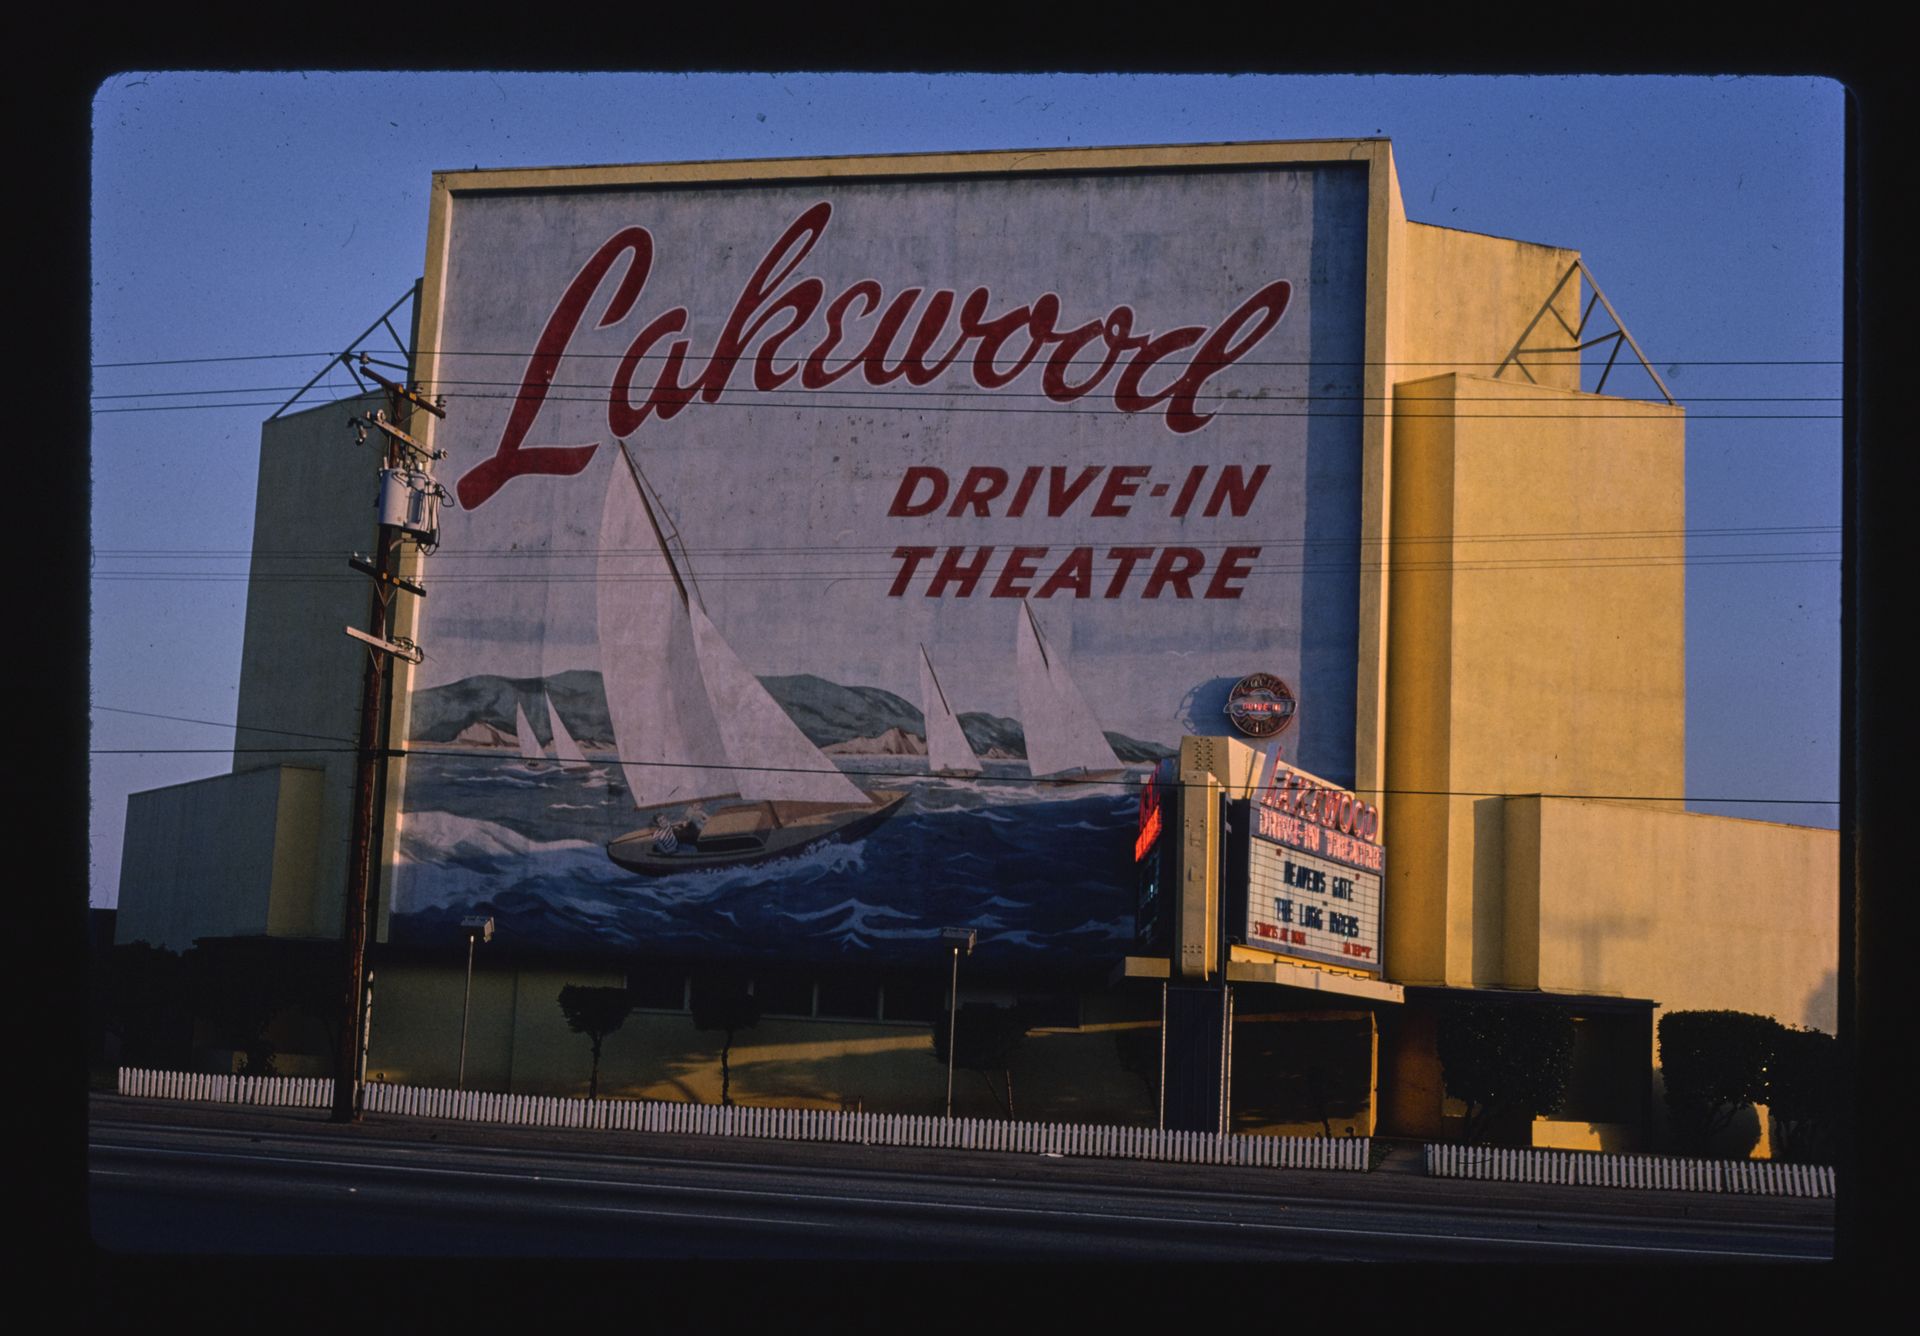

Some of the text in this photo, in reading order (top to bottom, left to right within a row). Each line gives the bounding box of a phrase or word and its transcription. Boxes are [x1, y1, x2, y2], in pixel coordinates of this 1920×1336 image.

[456, 201, 1292, 511] Lakewood
[887, 464, 1272, 518] DRIVE-IN
[887, 545, 1261, 600] THEATRE
[1325, 830, 1382, 869] THEATRE
[1274, 897, 1293, 922] THE
[1332, 876, 1354, 902] GATE
